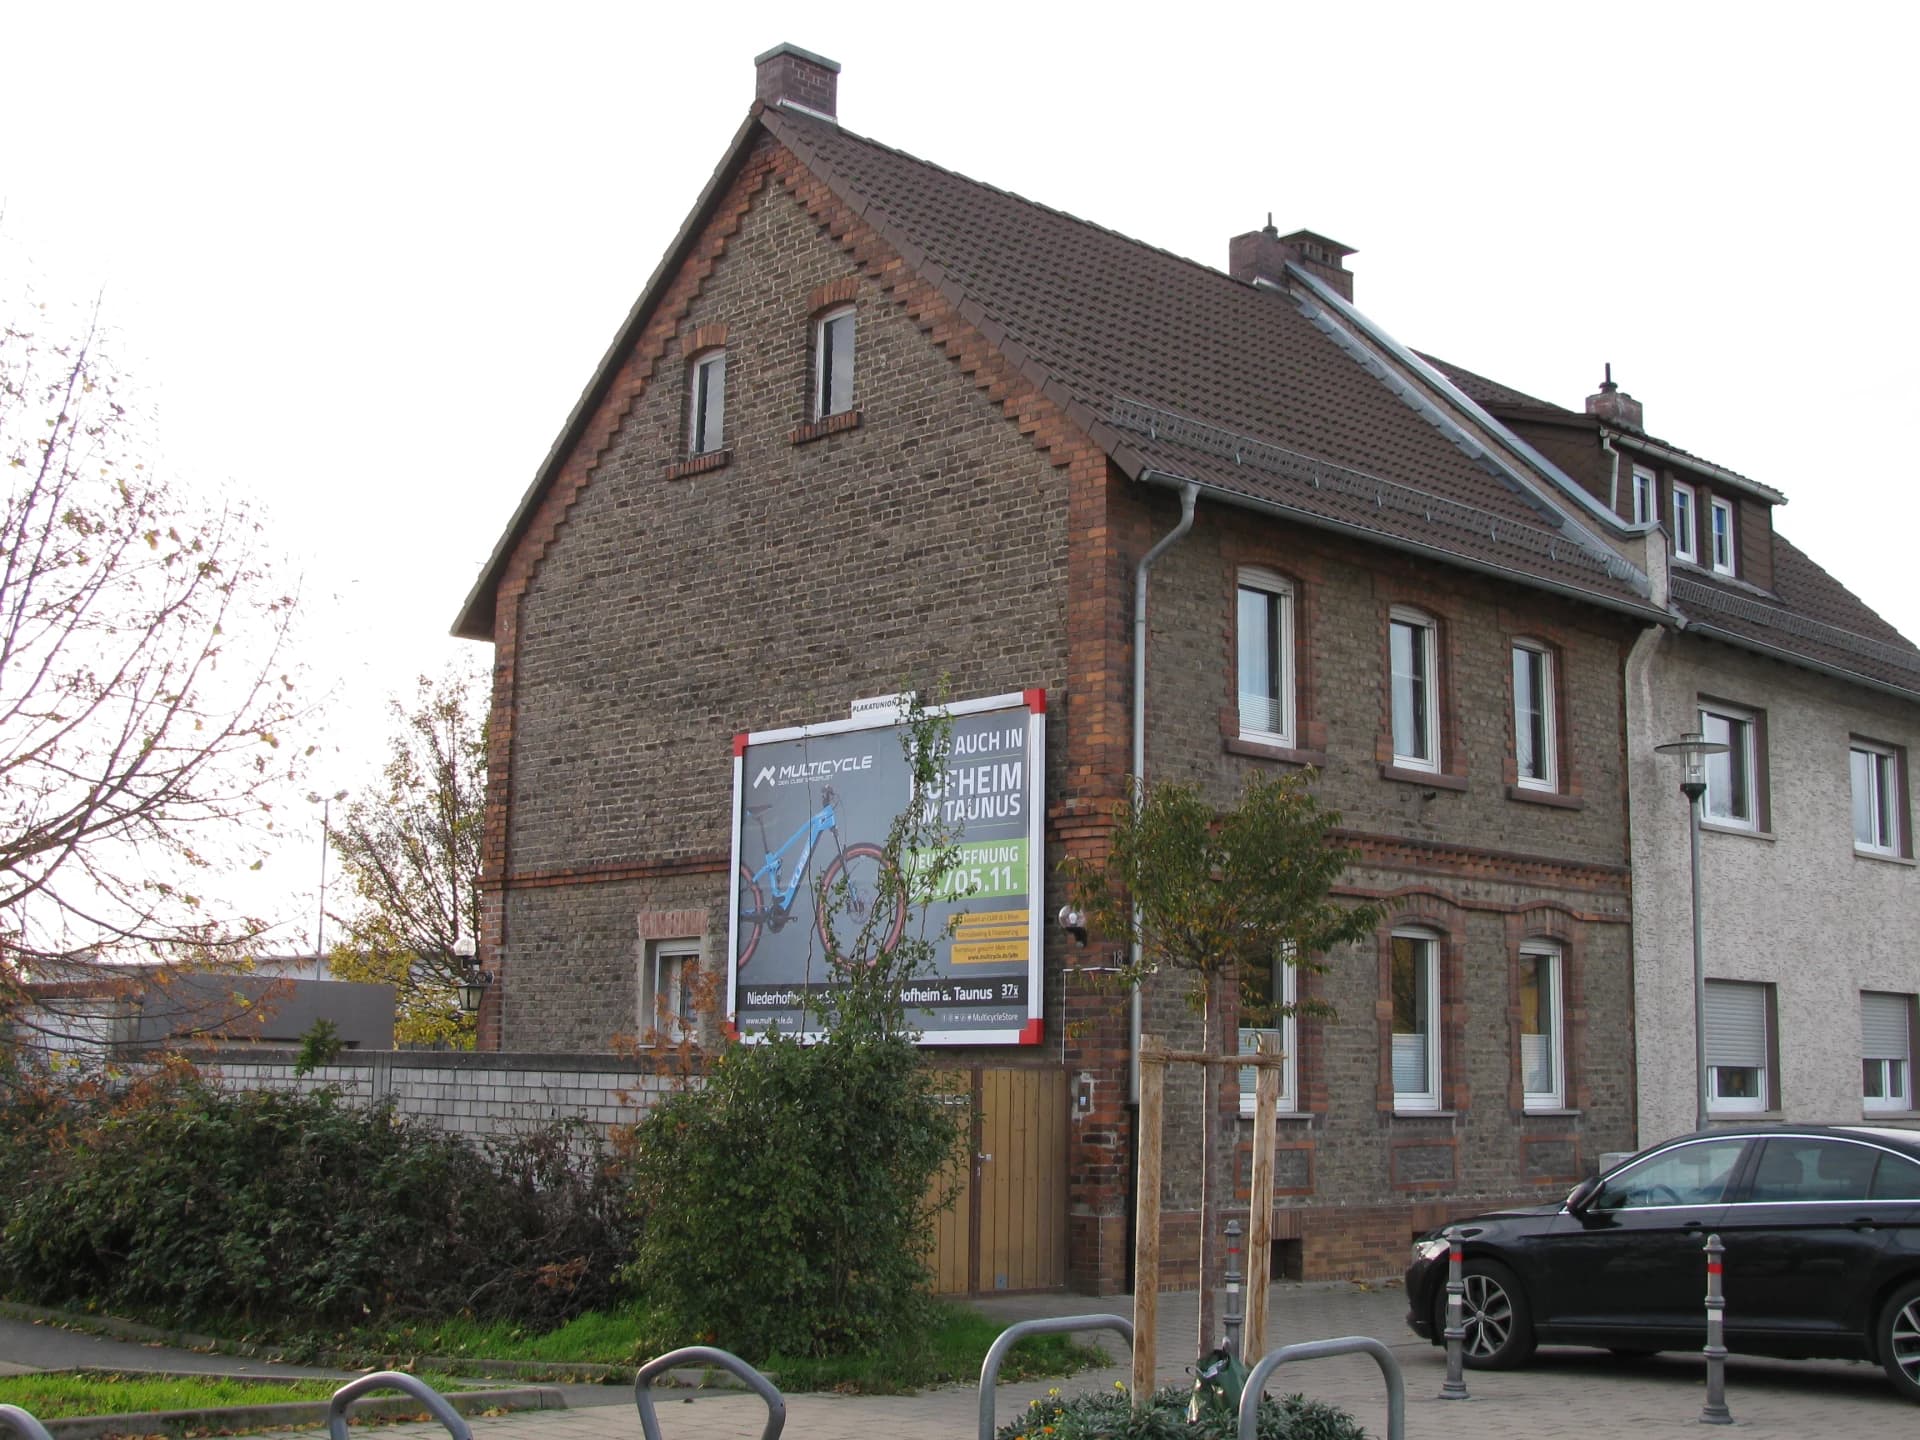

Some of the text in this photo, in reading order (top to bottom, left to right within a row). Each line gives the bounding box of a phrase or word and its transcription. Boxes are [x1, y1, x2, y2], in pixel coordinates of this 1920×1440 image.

[955, 731, 1000, 755] AUCH
[1005, 728, 1023, 749] IN
[779, 755, 873, 779] MULTICYCLE
[944, 793, 1021, 822] TAUNUS
[1113, 951, 1123, 967] 18
[953, 986, 993, 1001] Taunus
